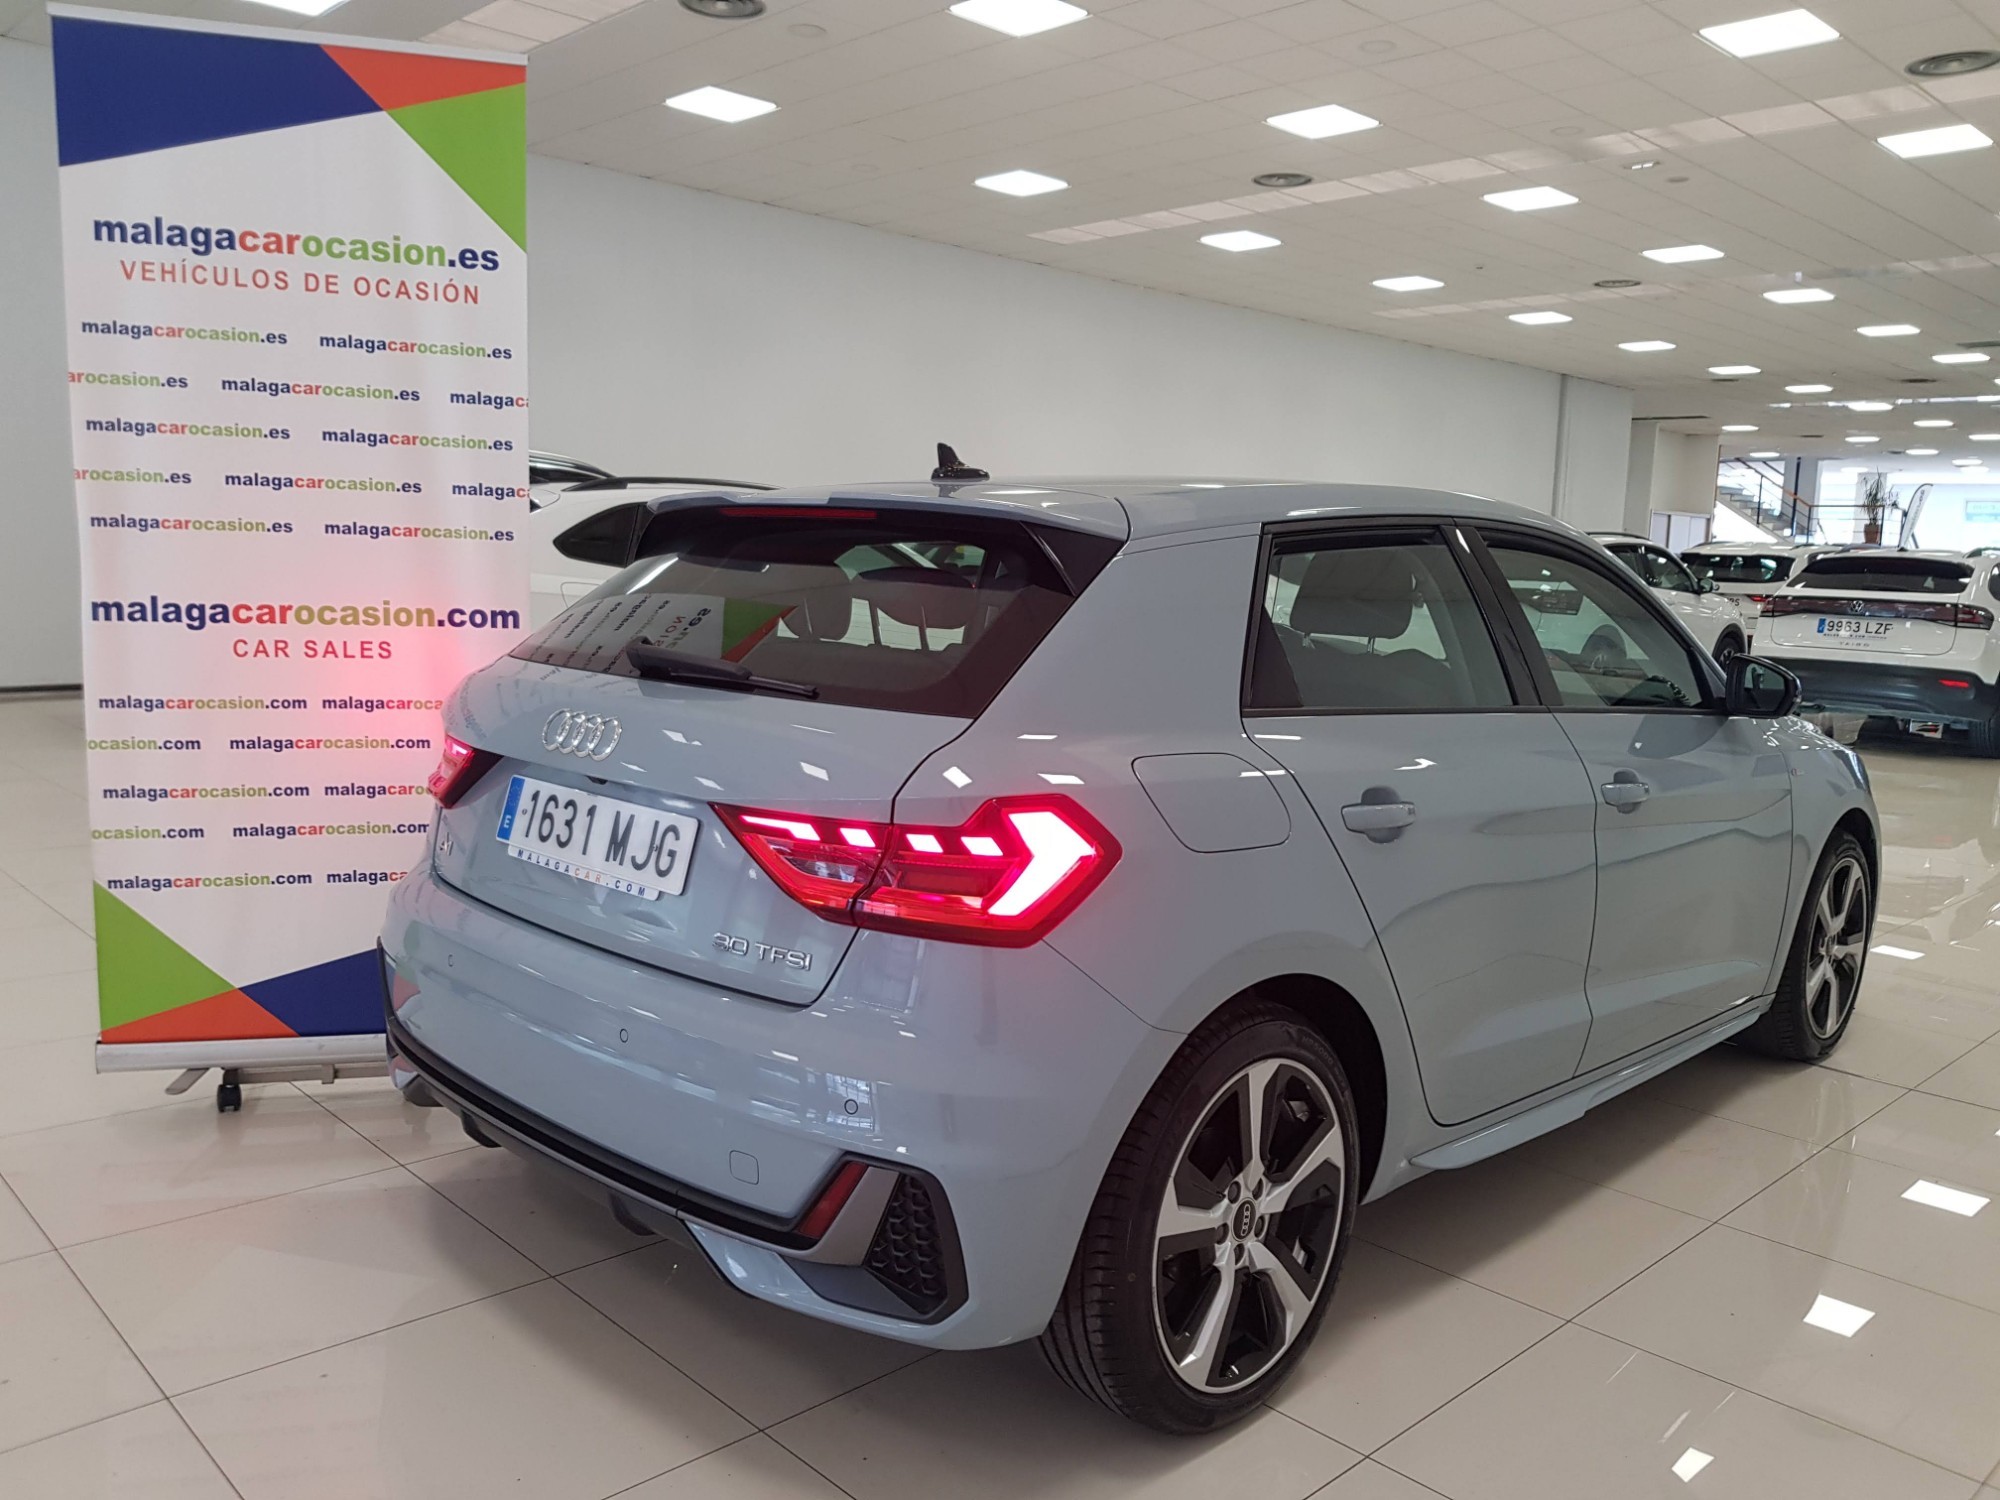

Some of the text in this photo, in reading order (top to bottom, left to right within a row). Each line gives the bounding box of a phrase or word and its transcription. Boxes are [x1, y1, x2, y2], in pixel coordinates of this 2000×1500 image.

[93, 216, 500, 271] malagacarocasion.es
[120, 259, 478, 304] VEHÍCULOS DE OCASIÓN
[82, 320, 287, 344] malagacarocasion.es
[320, 334, 512, 359] malagacarocasion.es
[222, 378, 420, 401] malagacarocasion.es
[450, 391, 529, 410] malagac
[86, 417, 290, 439] malagacarocasion.es
[322, 429, 513, 451] malagacarocasion.es
[225, 472, 422, 493] malagacarocasion.es
[452, 483, 529, 500] malagac
[90, 514, 293, 533] malagacarocasion.es
[325, 522, 514, 541] malagacarocasion.es
[91, 595, 520, 631] malagacarocasion.com
[1827, 620, 1894, 635] 9963 LZF
[233, 639, 392, 659] CAR SALES
[99, 695, 307, 712] malagacarocasion.com
[230, 736, 431, 751] malagacarocasion.com
[103, 784, 310, 800] malagacarocasion.com
[503, 814, 512, 829] E
[524, 789, 681, 879] 1631 MJG
[107, 872, 312, 890] malagacarocasion.com
[712, 931, 813, 971] 30 TFSI
